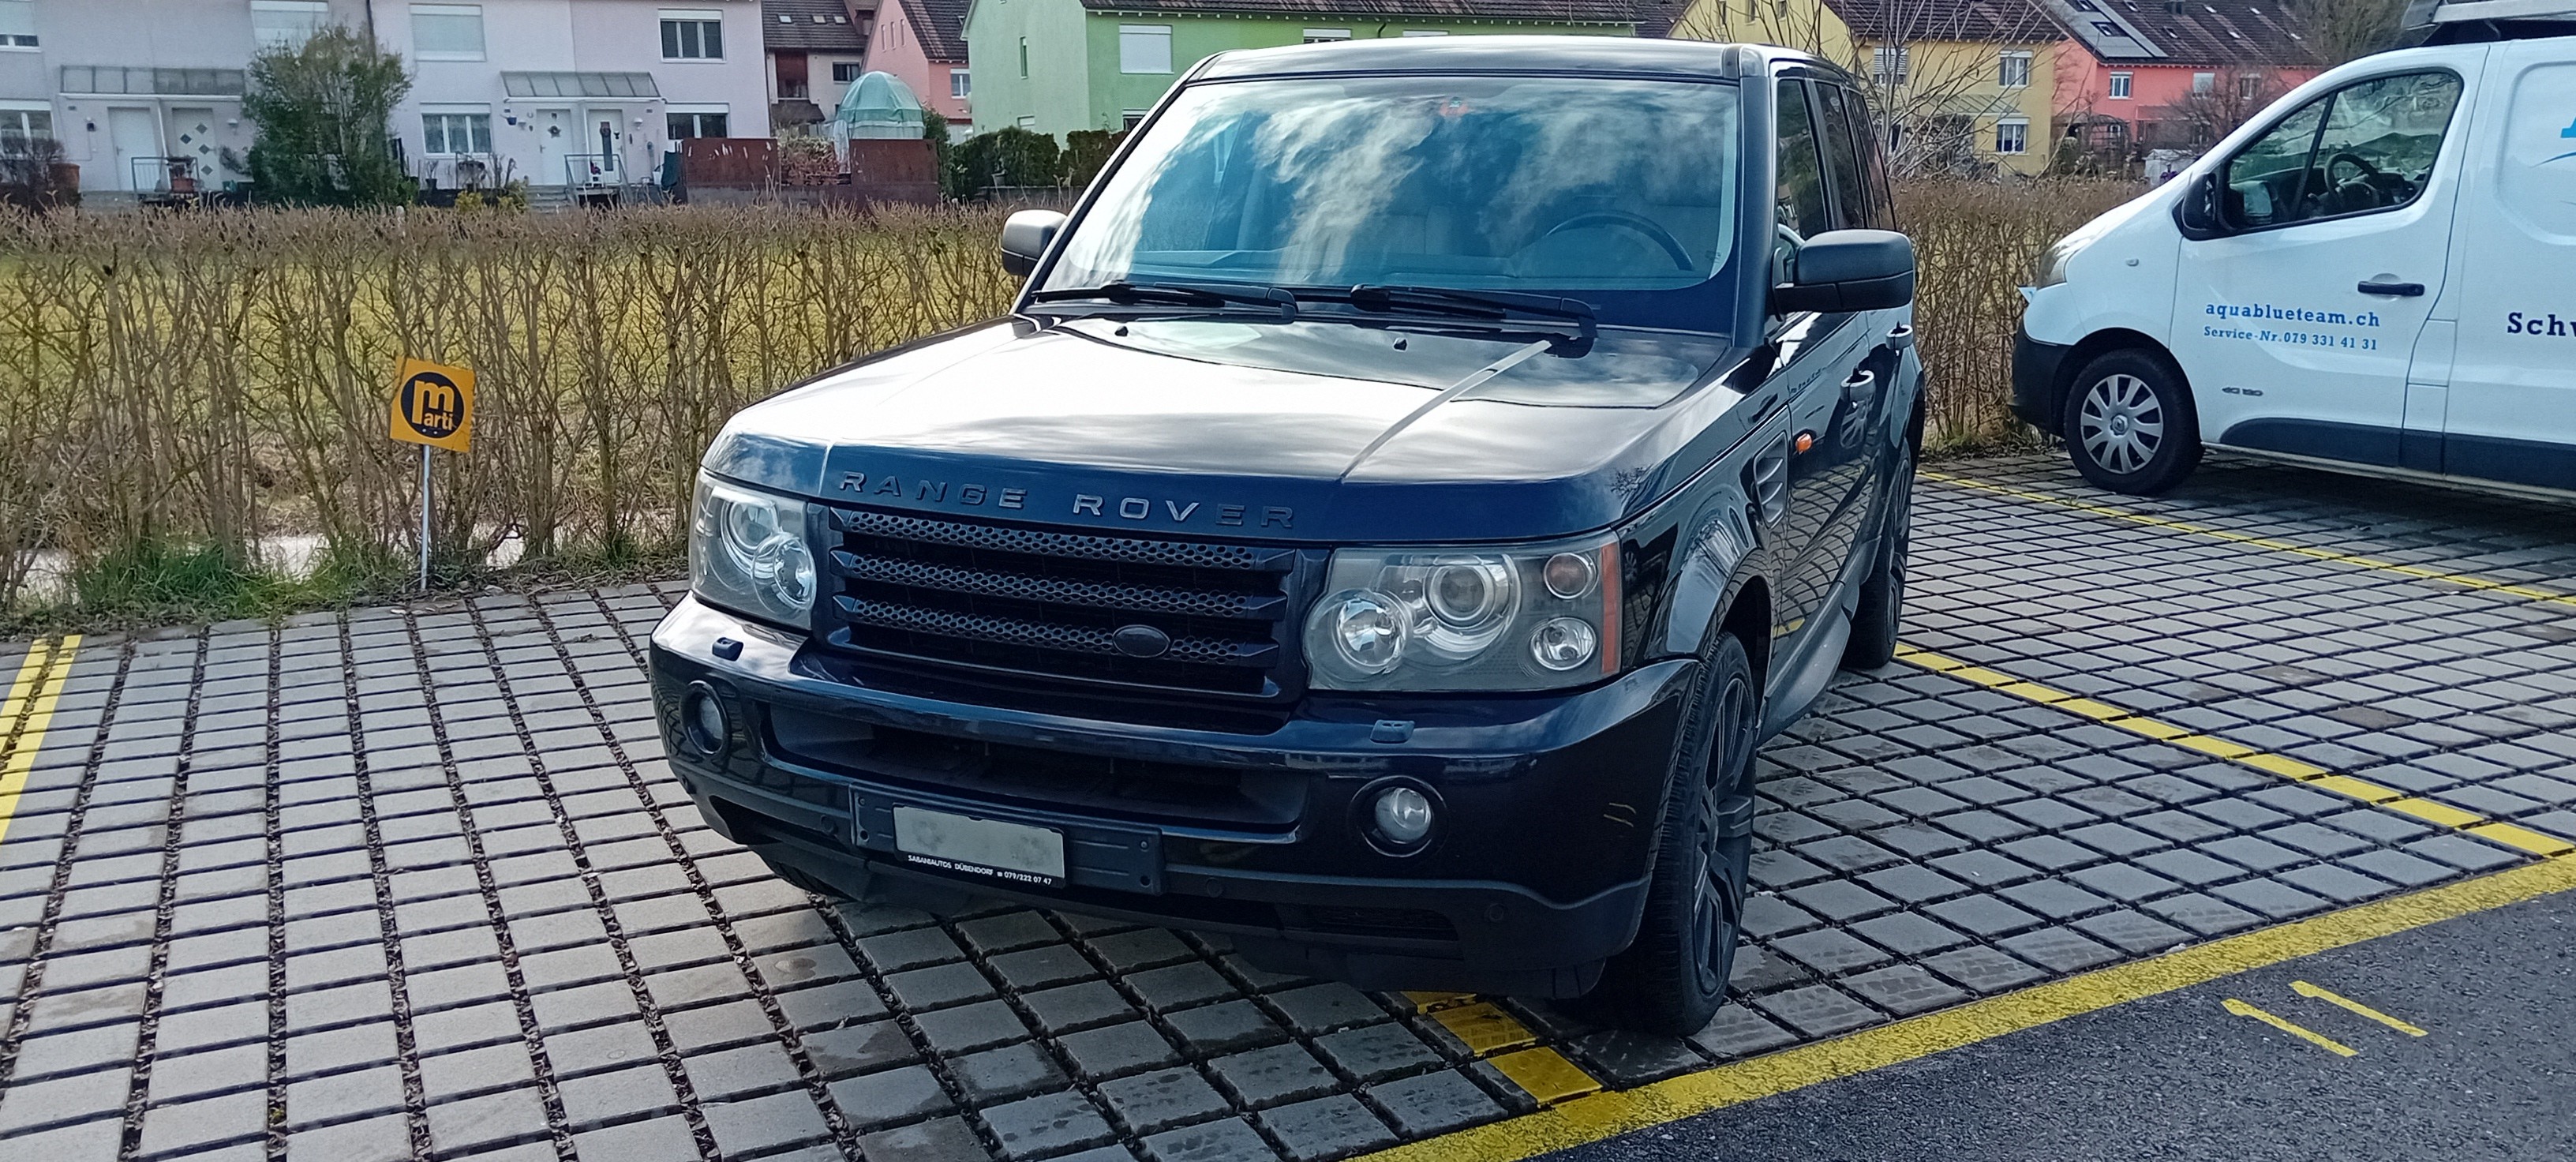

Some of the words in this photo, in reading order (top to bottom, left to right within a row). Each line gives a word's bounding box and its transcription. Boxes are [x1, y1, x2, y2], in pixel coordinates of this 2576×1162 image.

[2205, 303, 2380, 327] aquablueteam.ch
[2312, 334, 2334, 347] 331
[2340, 337, 2355, 348] 41
[2361, 339, 2377, 350] 31
[839, 470, 1028, 509] RANGE
[1073, 493, 1294, 528] ROVER
